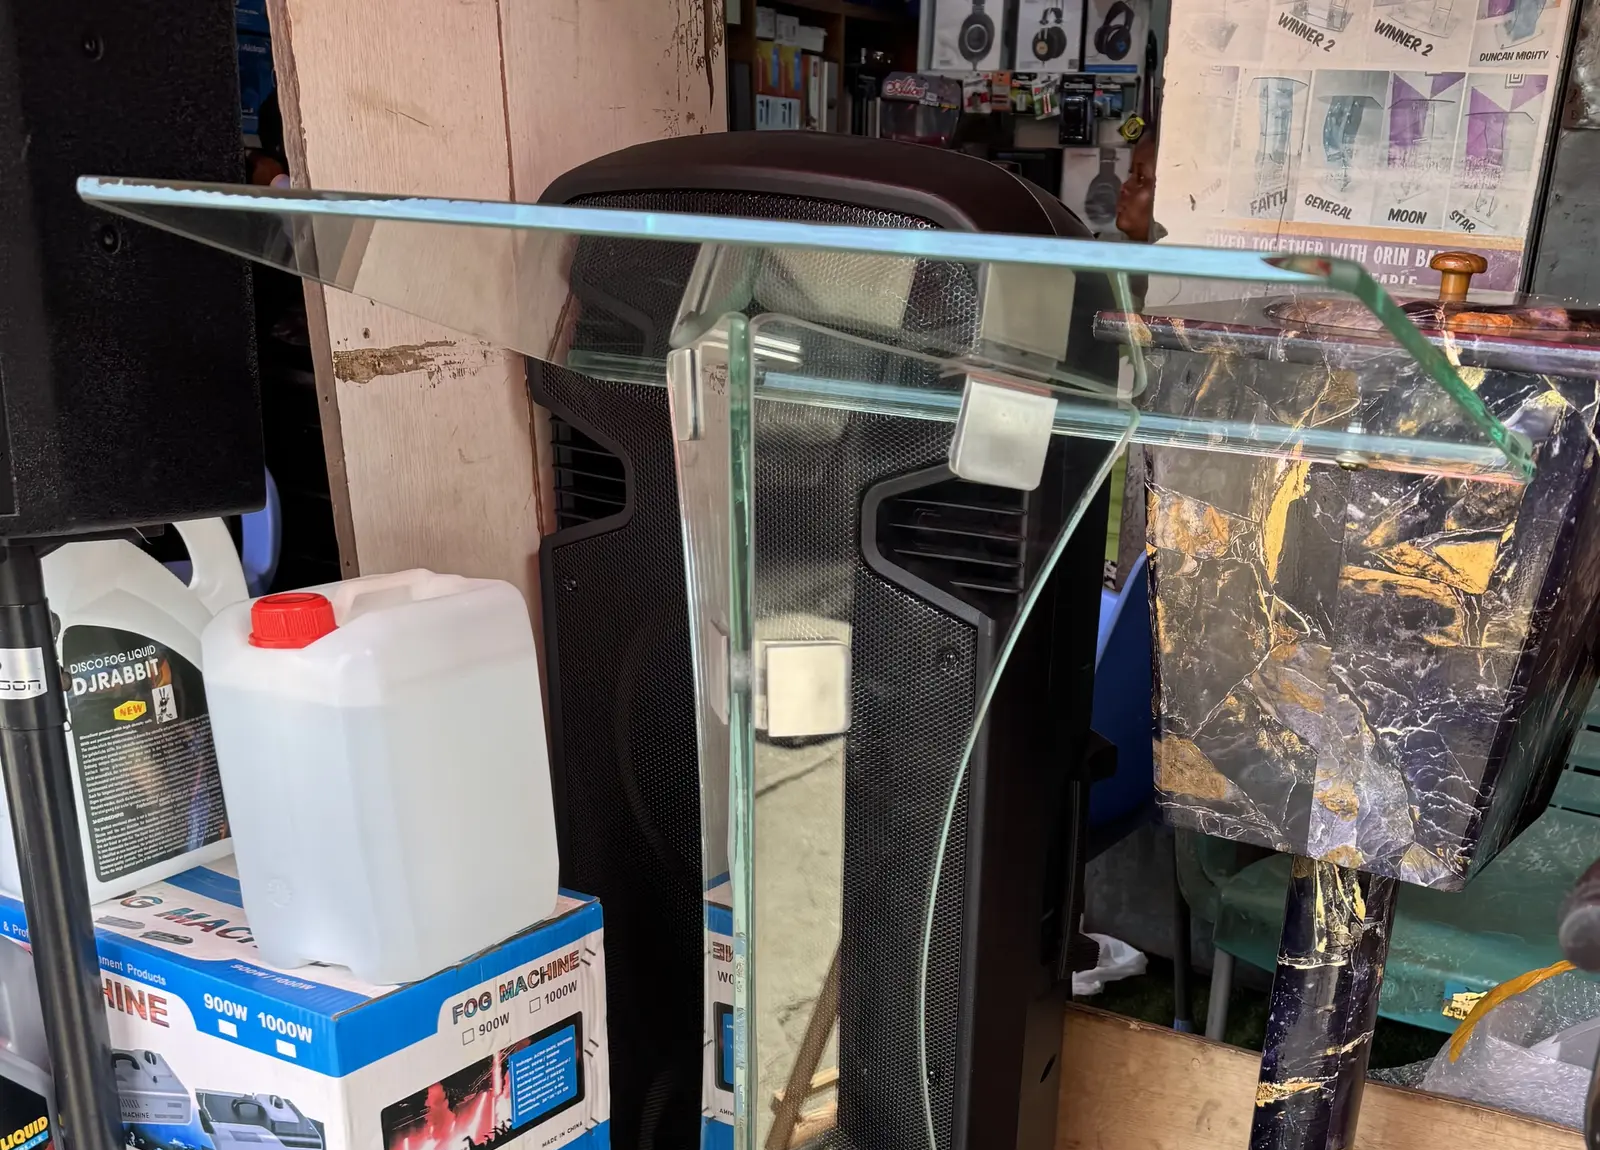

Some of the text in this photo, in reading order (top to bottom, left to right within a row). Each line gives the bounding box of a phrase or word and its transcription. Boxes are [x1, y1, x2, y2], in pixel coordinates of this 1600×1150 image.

[1278, 12, 1337, 53] WINNER 2
[1374, 19, 1434, 57] WINNER 2
[1479, 50, 1549, 62] DUNCAN MIGHTY
[1250, 188, 1289, 216] FAITH
[1305, 194, 1353, 221] GENERAL
[1388, 207, 1427, 225] MOON
[1449, 210, 1477, 233] STAR
[1251, 236, 1324, 253] TOGETHER
[1330, 242, 1366, 264] WITH
[1373, 245, 1410, 267] ORIN
[70, 645, 156, 675] DISCO FOG LIQUID
[72, 658, 158, 696] DJRABBIT
[120, 704, 144, 717] NEW
[3, 921, 10, 932] &
[127, 963, 167, 986] Products
[452, 950, 580, 1025] FOG MACHINE
[544, 980, 578, 1005] 1000W
[203, 993, 313, 1045] 900W 1000W
[479, 1012, 511, 1036] 900W
[122, 1112, 150, 1120] MACHINE
[542, 1136, 557, 1148] MADE
[567, 1121, 583, 1134] CHINA
